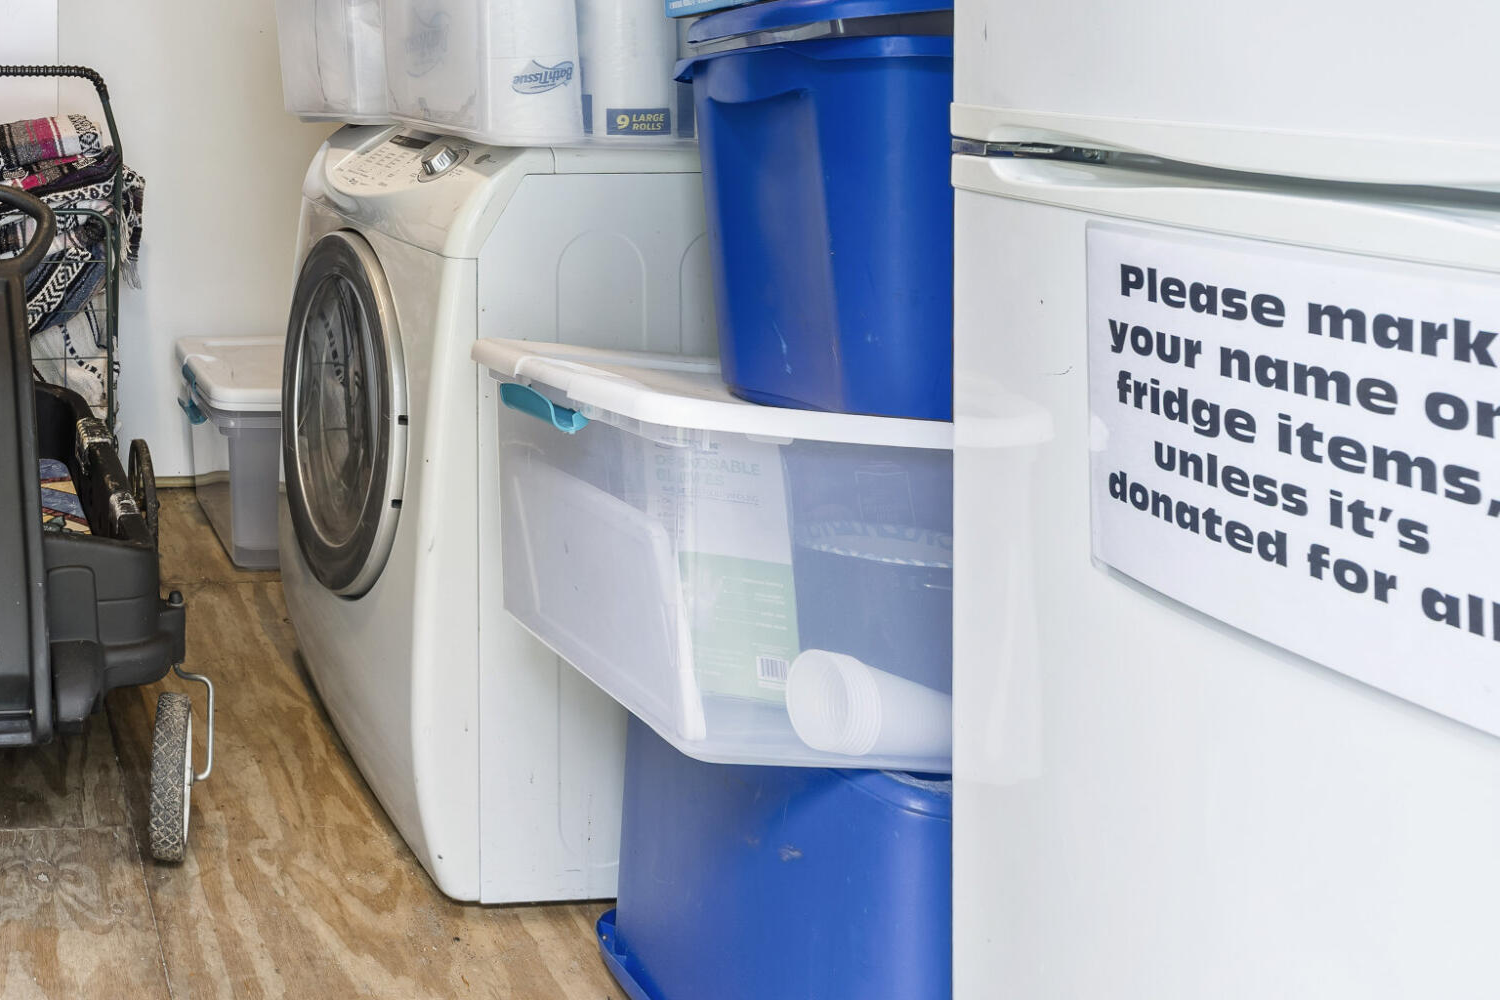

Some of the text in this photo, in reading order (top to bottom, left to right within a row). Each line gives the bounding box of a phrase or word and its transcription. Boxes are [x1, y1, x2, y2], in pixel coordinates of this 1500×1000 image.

[513, 66, 575, 87] BathTissue
[616, 113, 665, 130] 9 LARGE
[632, 122, 662, 131] ROLLS
[1120, 263, 1498, 368] Please mark
[1108, 318, 1202, 369] your
[1219, 345, 1399, 416] name
[1117, 371, 1500, 517] fridge items,
[1153, 441, 1309, 516] unless
[1108, 471, 1288, 567] donated
[1307, 544, 1398, 603] for
